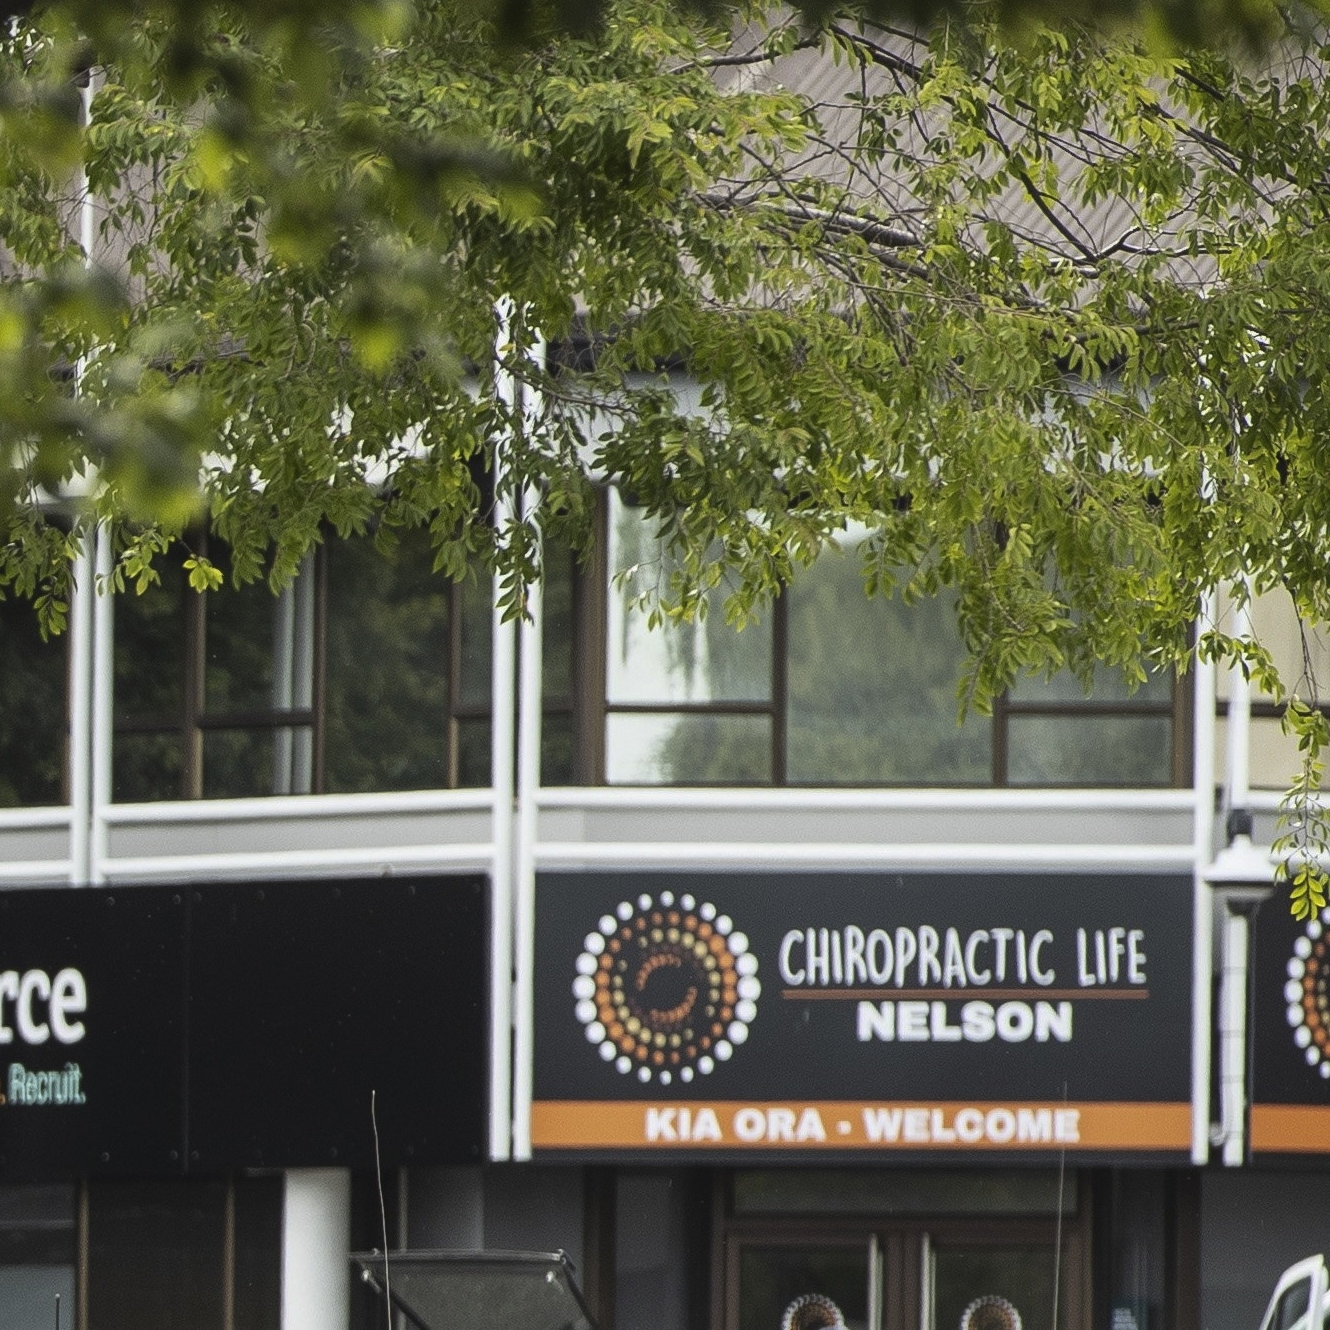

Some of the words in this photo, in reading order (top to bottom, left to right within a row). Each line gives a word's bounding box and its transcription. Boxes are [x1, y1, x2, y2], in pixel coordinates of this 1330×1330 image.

[778, 925, 1056, 988] CHIROPRACTIC
[1076, 926, 1148, 987] LIFE
[856, 1000, 1073, 1042] NELSON
[645, 1107, 723, 1142] KIA
[733, 1107, 827, 1142] ORA
[862, 1107, 1081, 1143] WELCOME
